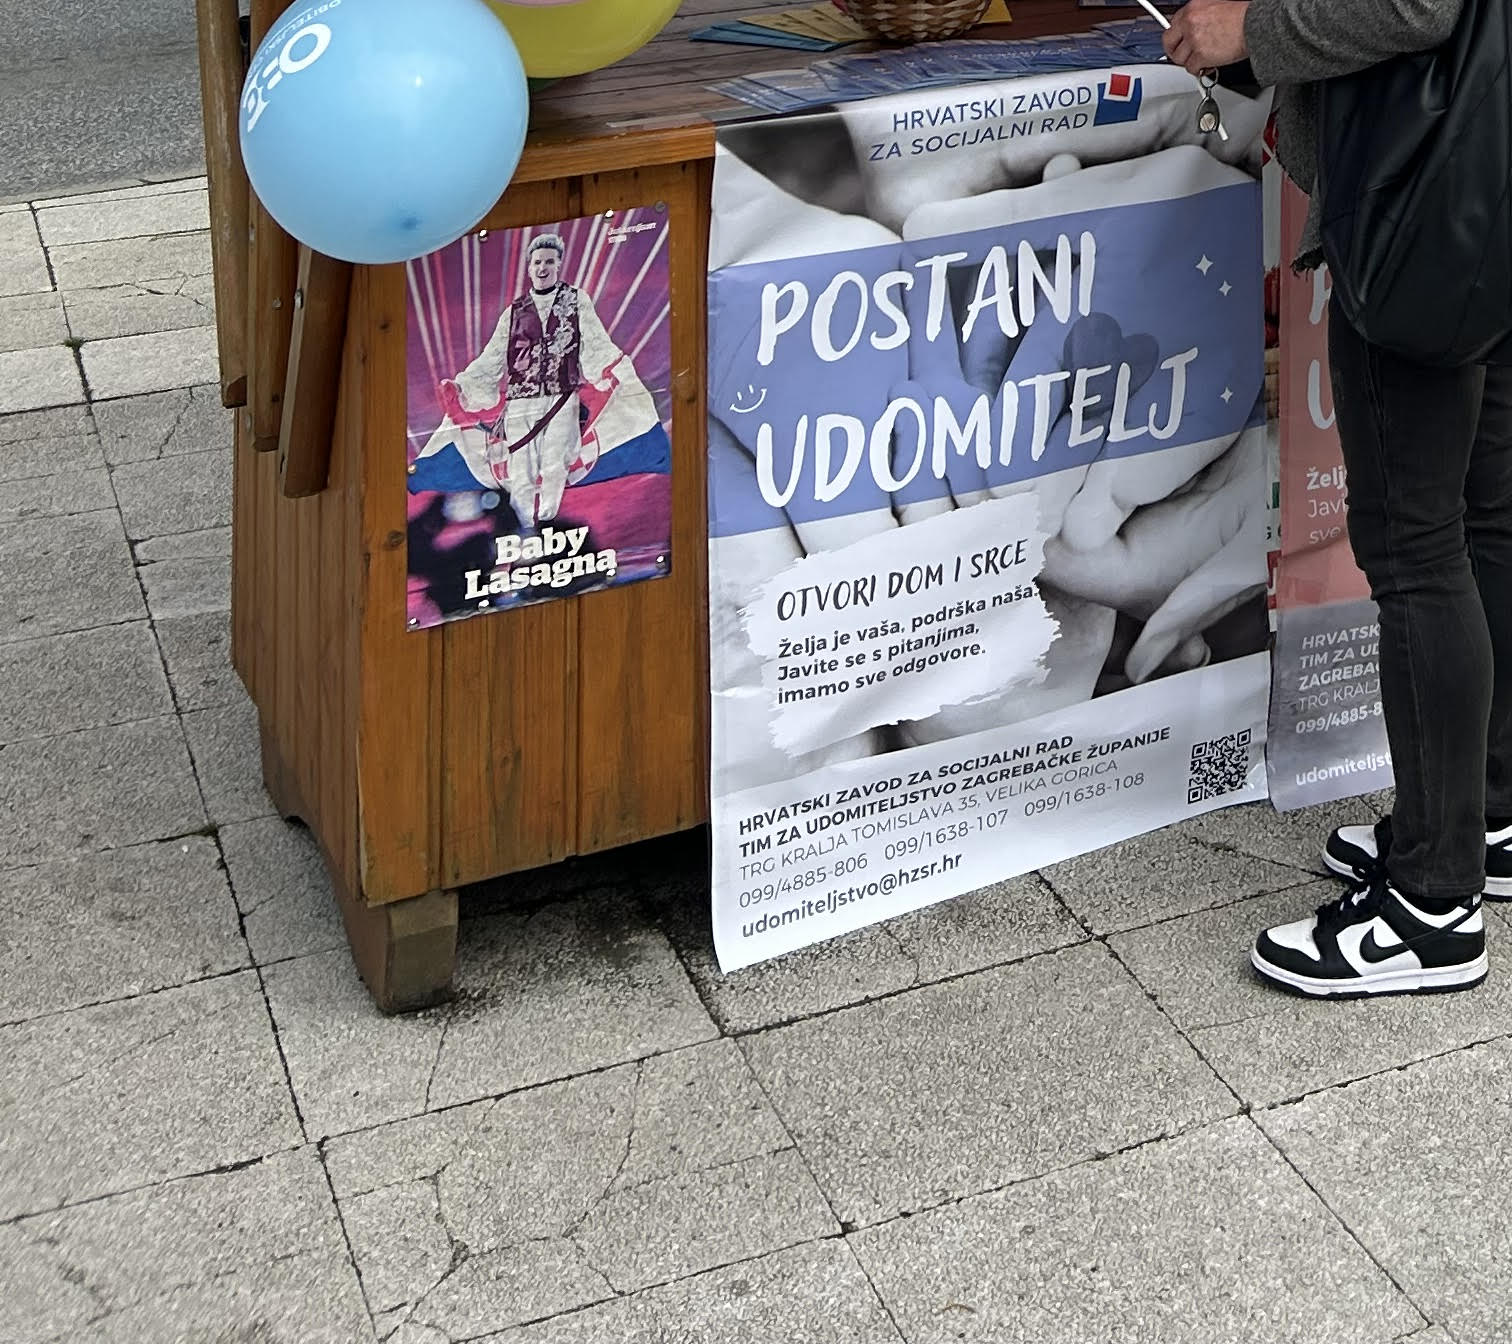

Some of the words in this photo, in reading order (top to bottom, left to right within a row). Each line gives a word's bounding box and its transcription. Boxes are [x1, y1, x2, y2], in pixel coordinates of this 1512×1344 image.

[869, 142, 902, 161] ZA
[910, 120, 1034, 155] SOCIJALNI
[1040, 113, 1088, 134] RAD
[893, 98, 1004, 132] HRVATSKI
[1012, 86, 1092, 115] ZAVOD
[757, 231, 1097, 367] POSTANI
[754, 347, 1199, 508] UDOMITELJ
[1306, 467, 1346, 491] Želj
[495, 525, 591, 567] Baby
[1309, 525, 1341, 545] sve
[464, 547, 618, 601] Lasagna
[777, 574, 876, 621] OTVORI
[888, 564, 943, 599] DOM
[954, 556, 961, 582] I
[970, 538, 1028, 578] SRCE
[778, 637, 827, 659] Želja
[831, 630, 850, 652] je
[857, 619, 906, 642] vaša,
[911, 599, 986, 633] podrška
[991, 583, 1039, 609] naša.
[1302, 623, 1380, 650] HRVATSK
[778, 658, 838, 681] Javite
[845, 652, 866, 668] se
[872, 649, 881, 661] s
[888, 622, 980, 662] pitanjima,
[778, 680, 850, 705] imamo
[855, 670, 887, 689] sve
[892, 642, 986, 678] odgovore.
[1299, 664, 1380, 691] ZAGREBA
[1300, 652, 1328, 669] TIM
[1332, 646, 1355, 664] ZA
[1296, 701, 1382, 734] 099/4885-8
[1298, 694, 1329, 712] TRG
[1333, 679, 1380, 706] KRALJ
[739, 793, 830, 836] HRVATSKI
[836, 777, 902, 805] ZAVOD
[907, 770, 932, 786] ZA
[938, 746, 1030, 778] SOCIJALNI
[1036, 735, 1073, 755] RAD
[739, 836, 771, 858] TIM
[777, 825, 801, 846] ZA
[806, 781, 956, 835] UDOMITELJSTVO
[961, 750, 1082, 791] ZAGREBAČKE
[1087, 726, 1171, 759] ŽUPANIJE
[739, 857, 775, 881] TRG
[781, 833, 848, 868] KRALJA
[851, 801, 954, 843] TOMISLAVA
[959, 793, 981, 811] 35,
[986, 778, 1047, 803] VELIKA
[1051, 759, 1118, 785] GORICA
[739, 853, 868, 908] 099/4885-806
[885, 809, 1009, 861] 099/1638-107
[1024, 772, 1145, 817] 099/1638-108
[742, 853, 963, 938] udomiteljstvo@hzsr.hr
